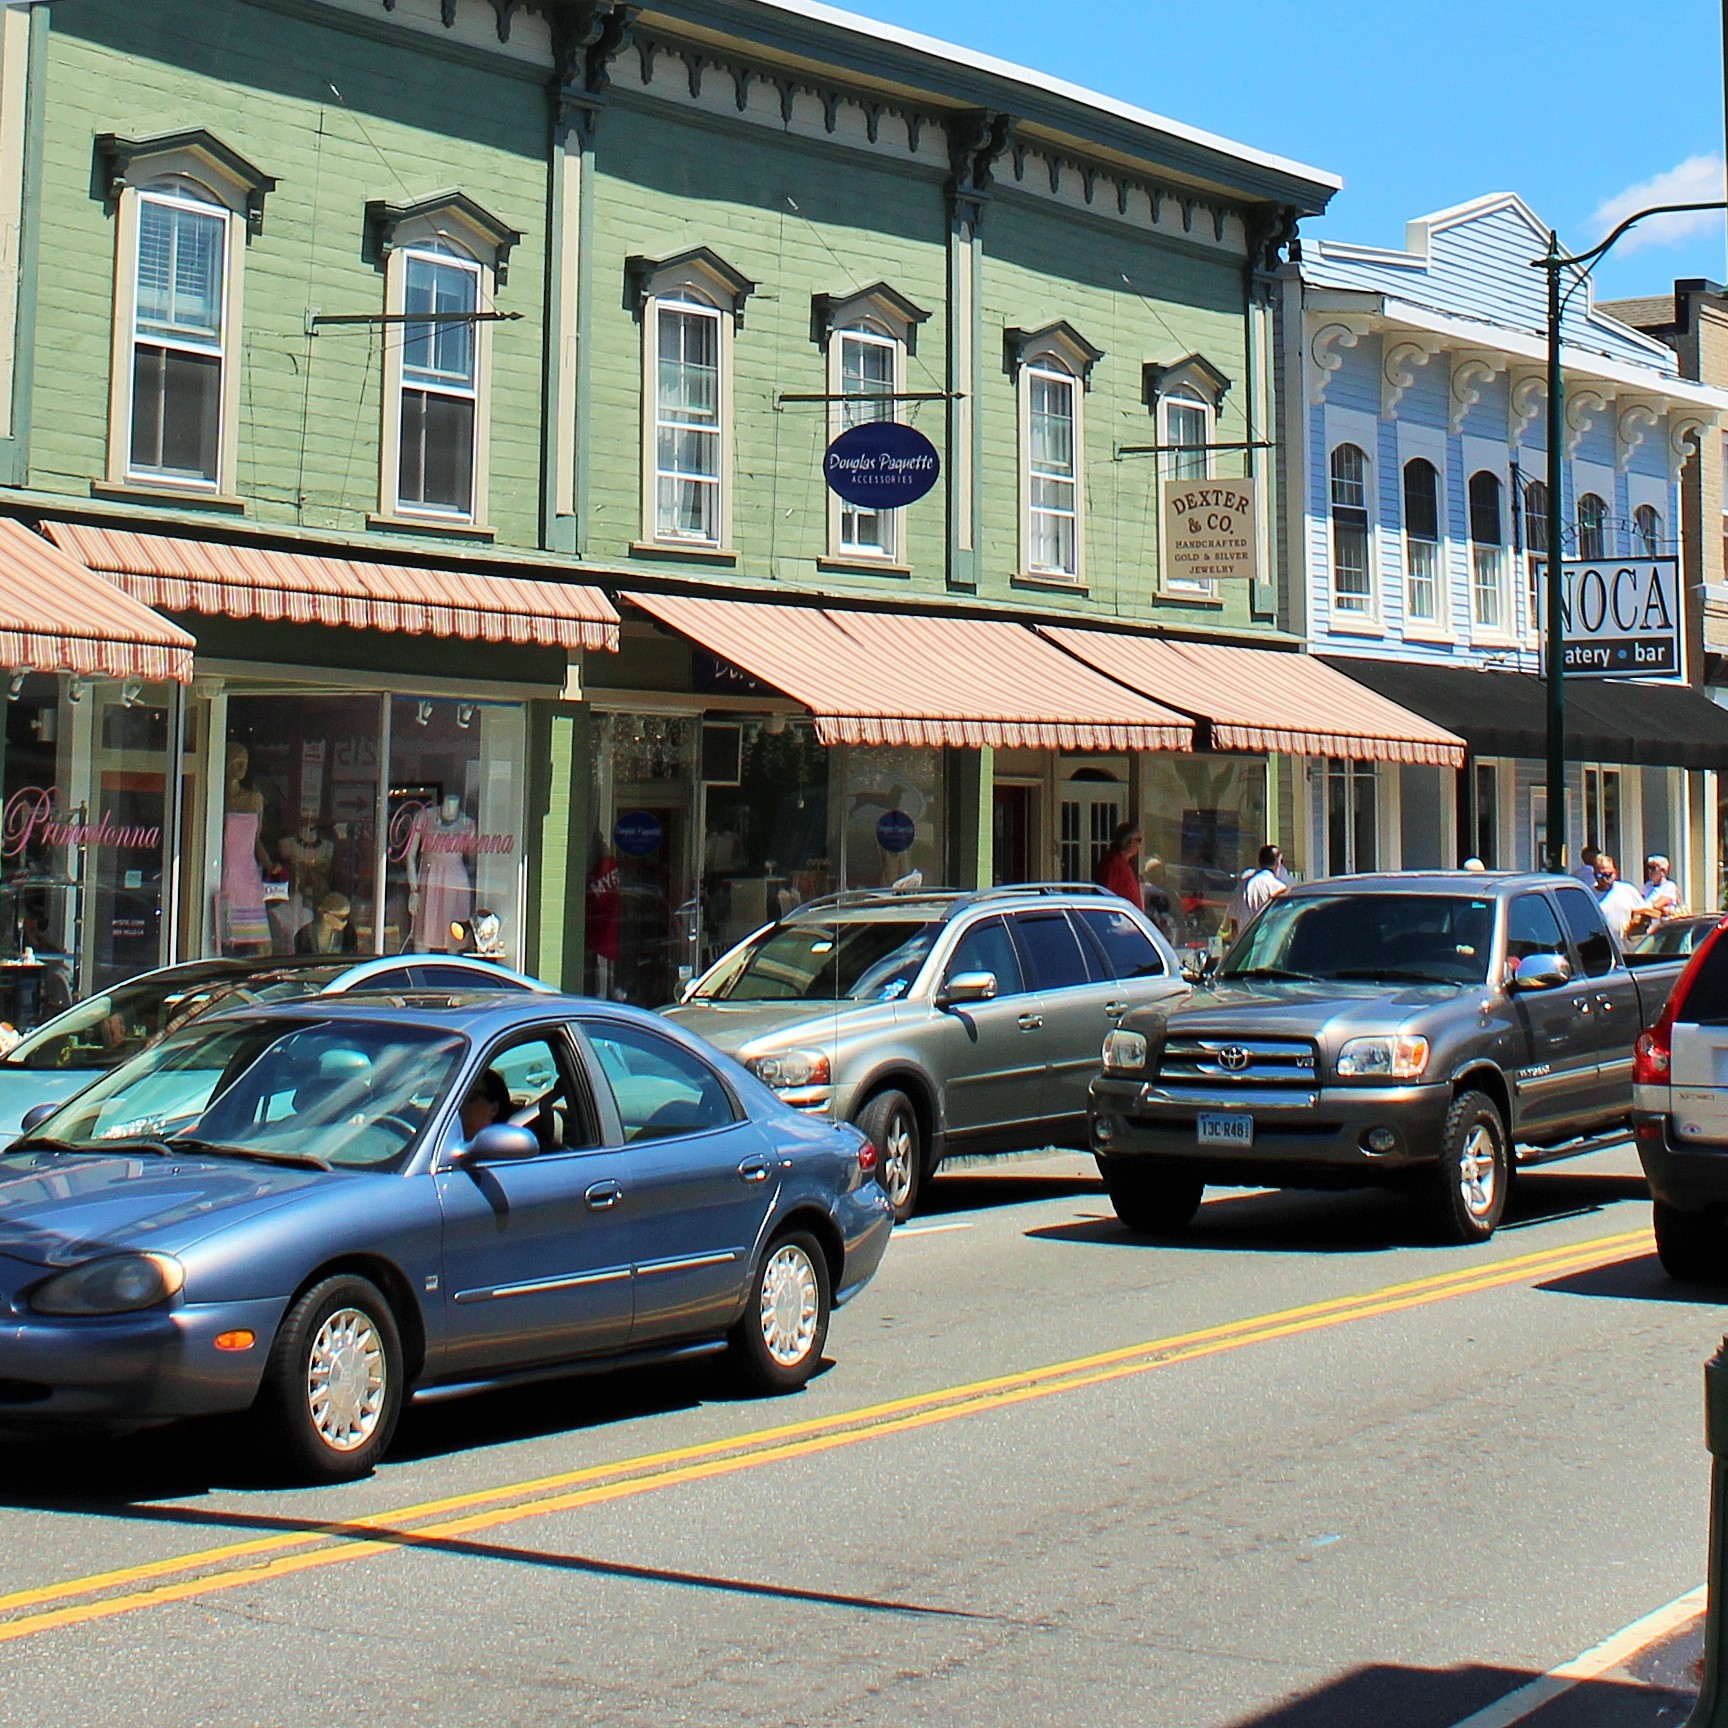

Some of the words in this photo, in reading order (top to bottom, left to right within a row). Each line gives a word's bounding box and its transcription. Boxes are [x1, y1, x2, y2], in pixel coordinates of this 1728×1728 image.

[828, 453, 877, 473] Douglas
[878, 453, 934, 474] Paquette
[851, 475, 913, 485] ACCESSORIES
[1172, 489, 1249, 515] DEXTER
[1188, 517, 1202, 534] &
[1207, 513, 1234, 535] CO.
[1175, 539, 1247, 549] HANDCRAFTED
[1174, 553, 1200, 562] GOLD
[1214, 552, 1249, 561] SILVER
[1189, 565, 1235, 574] JEWELRY
[1564, 644, 1611, 667] atery
[1634, 641, 1666, 663] bar
